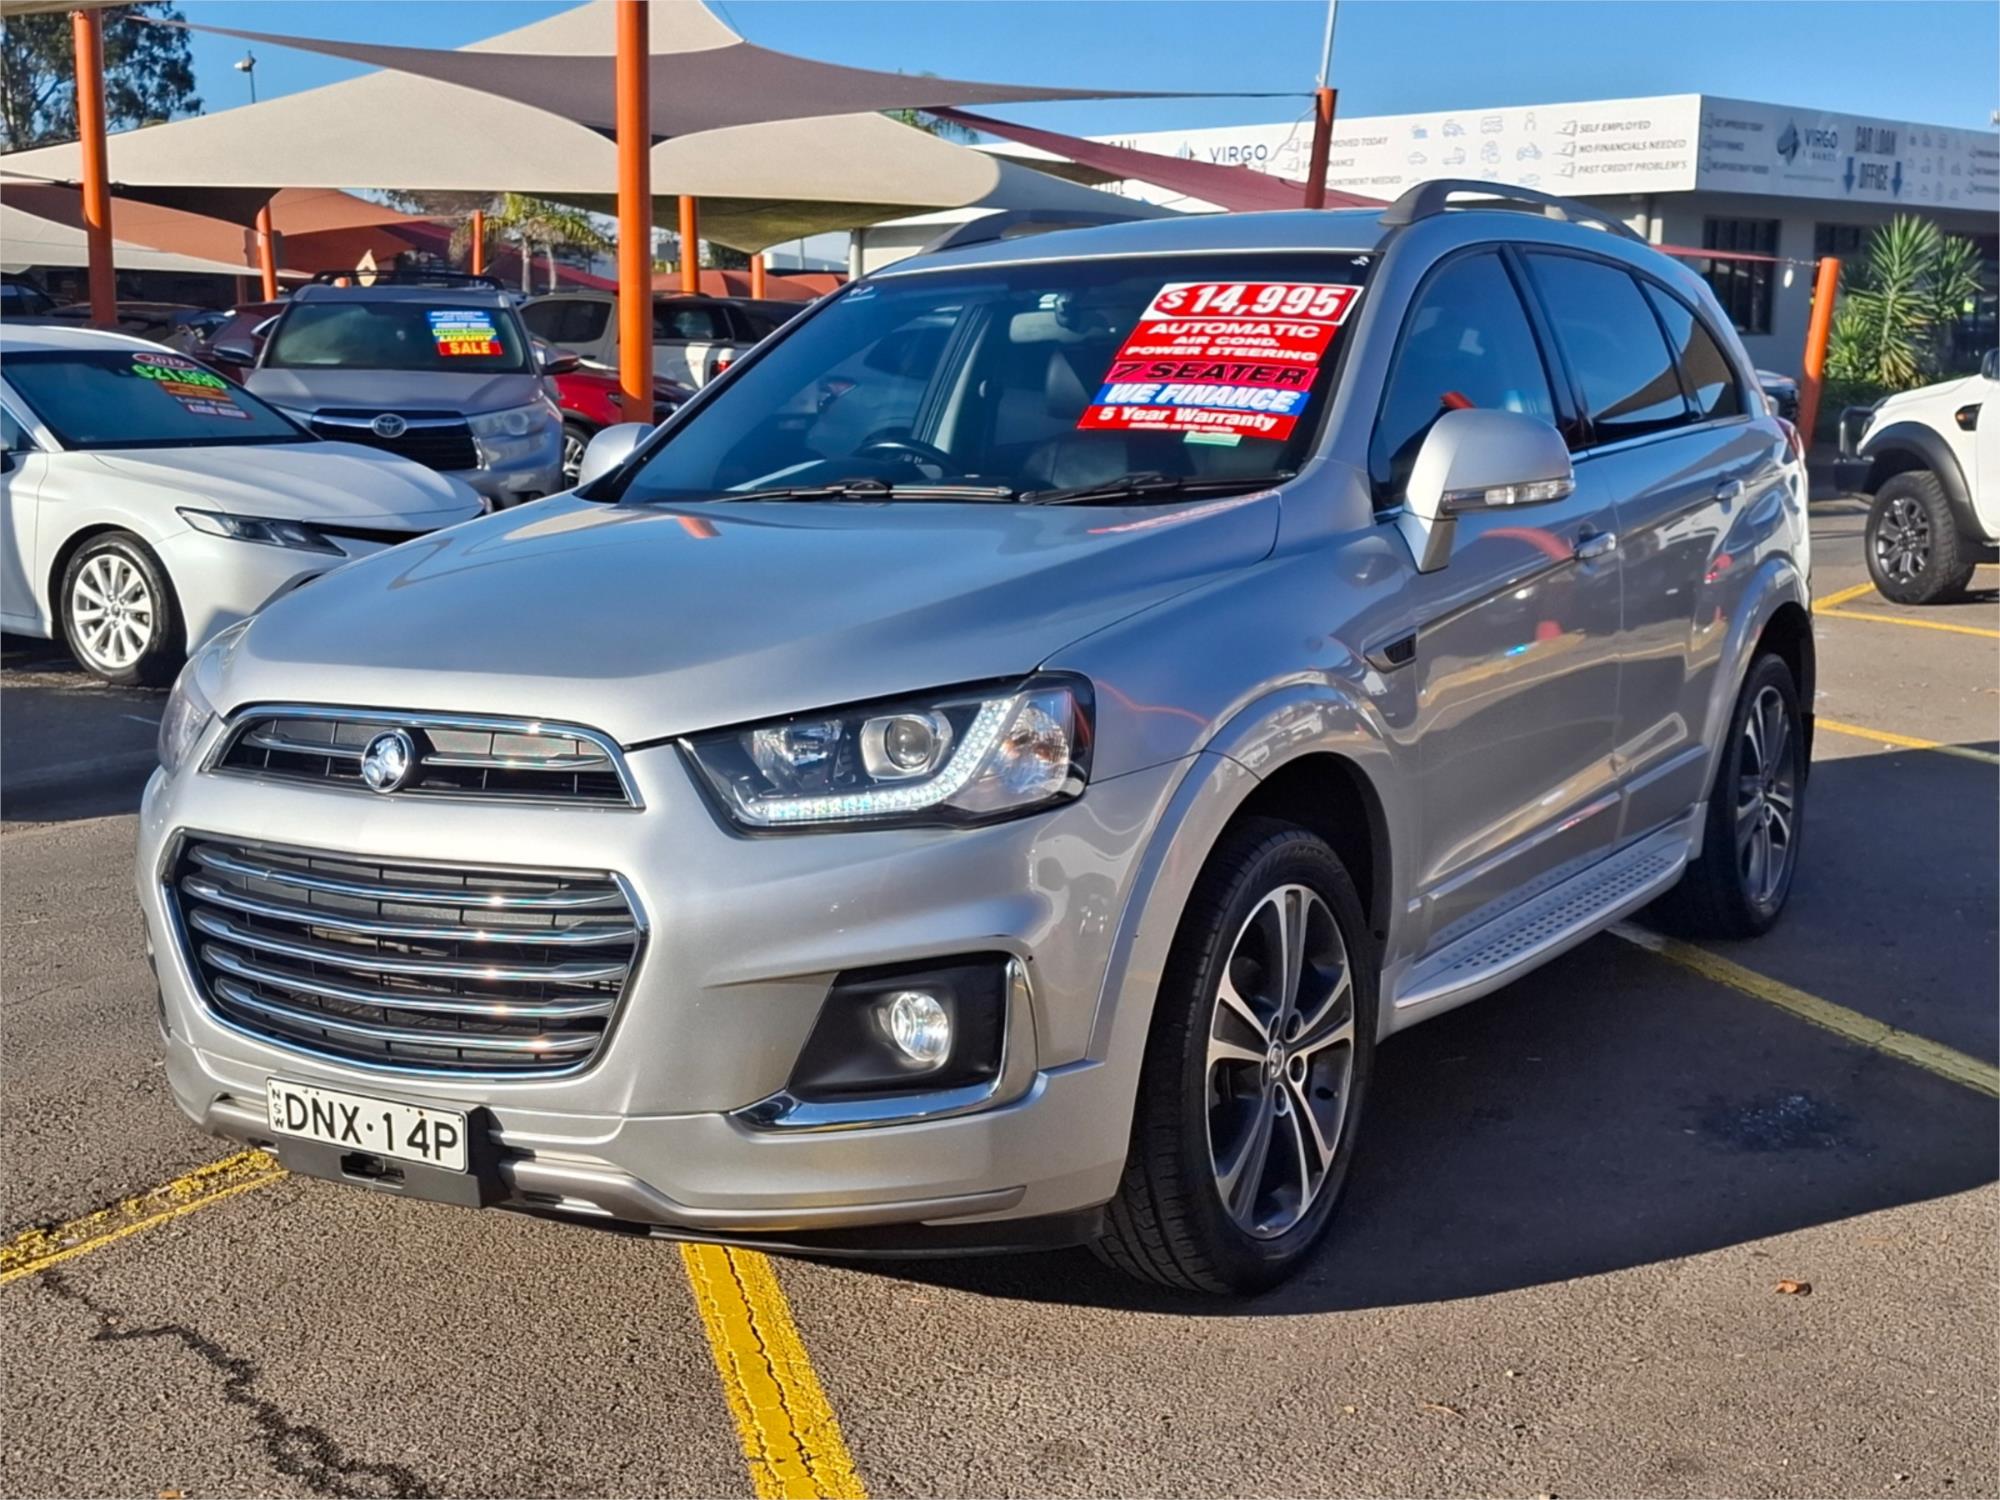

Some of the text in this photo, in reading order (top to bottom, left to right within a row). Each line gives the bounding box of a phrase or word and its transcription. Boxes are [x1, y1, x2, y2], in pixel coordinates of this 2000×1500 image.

[1579, 120, 1651, 133] SELF EMPLOYED
[1593, 141, 1647, 152] FINANCIALS
[1649, 139, 1687, 149] NEEDED
[1804, 128, 1838, 149] VIRGO
[1209, 144, 1268, 164] VIRGO
[1578, 164, 1599, 174] PAST
[1601, 162, 1633, 173] CREDIT
[1190, 285, 1346, 317] 14,995
[1148, 322, 1321, 338] AUTOMATIC
[449, 341, 491, 355] SALE
[1173, 336, 1280, 347] AIR COND.
[1125, 345, 1318, 361] POWER STEERING
[1111, 363, 1308, 384] 7 SEATER
[1104, 384, 1300, 412] WE FINANCE
[1098, 406, 1278, 431] 5 Year Warranty
[271, 1088, 285, 1129] NSW
